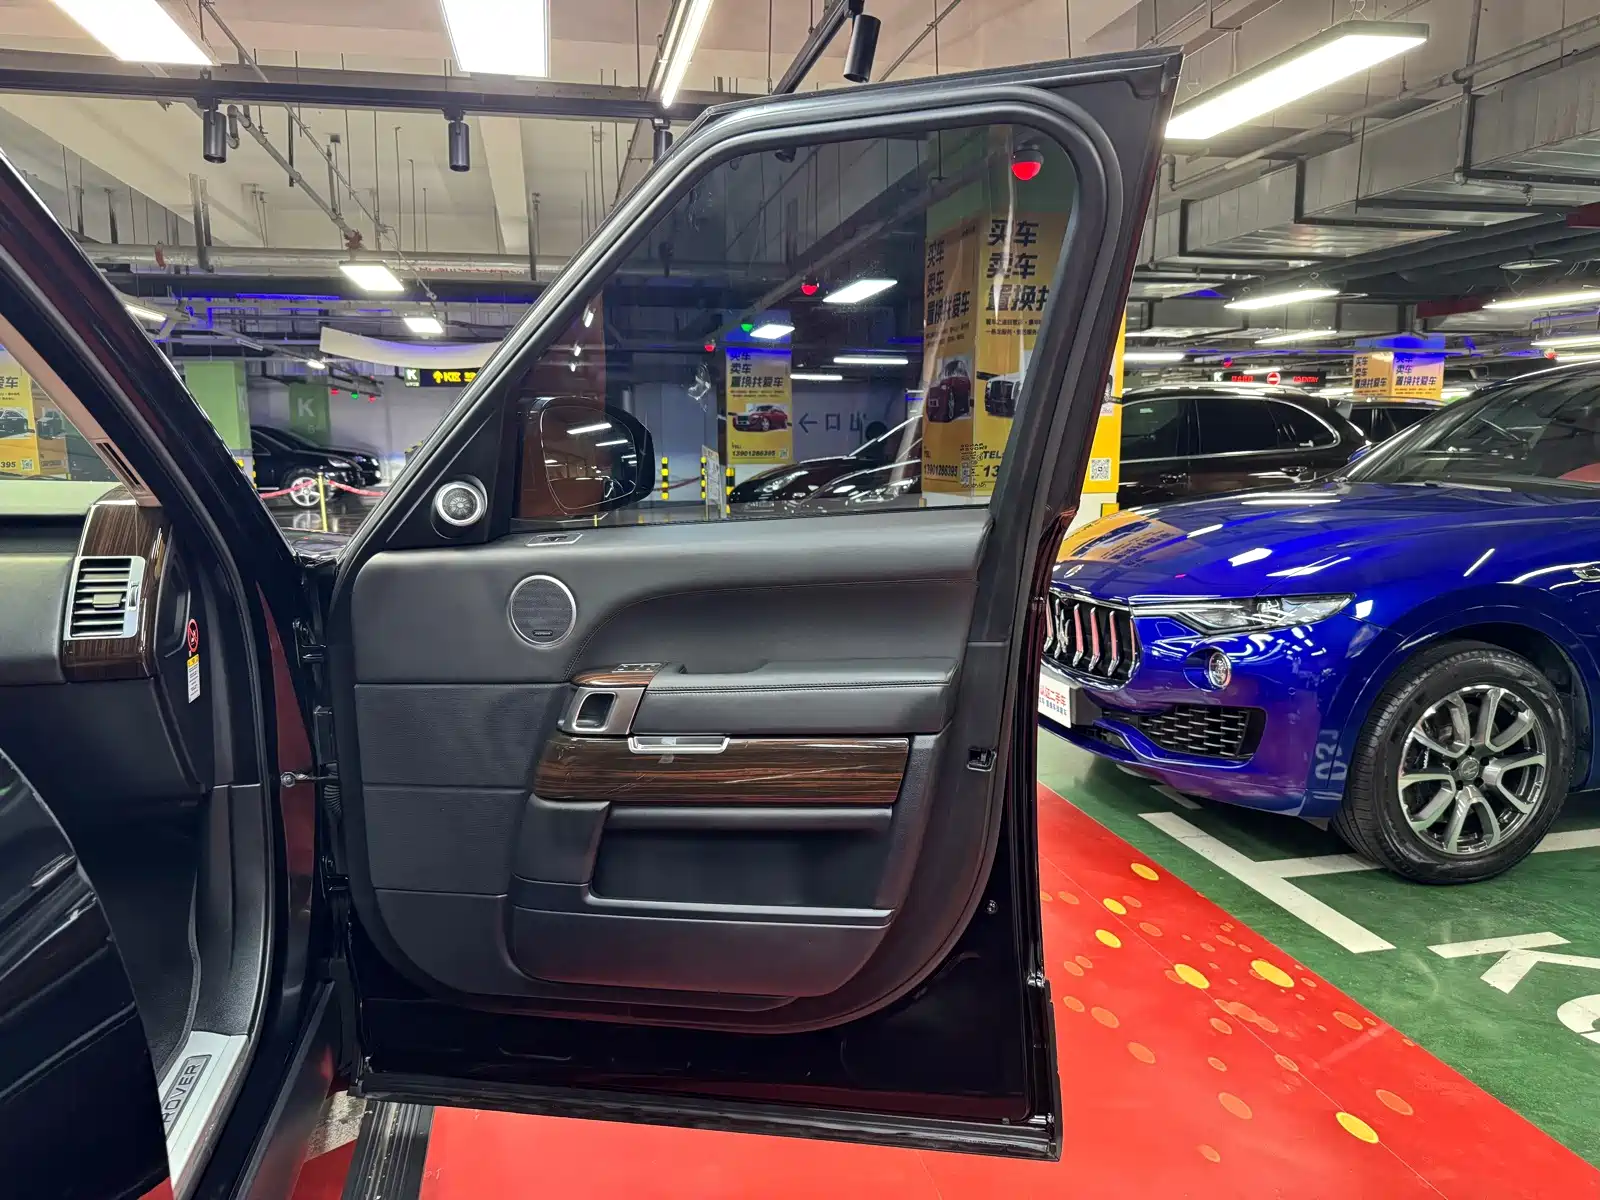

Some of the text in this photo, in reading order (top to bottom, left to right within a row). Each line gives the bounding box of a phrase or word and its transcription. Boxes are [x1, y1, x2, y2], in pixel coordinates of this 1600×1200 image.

[987, 219, 1039, 247] 买车
[986, 252, 1038, 279] 卖车
[297, 397, 315, 417] K
[162, 1064, 200, 1123] ROVER
